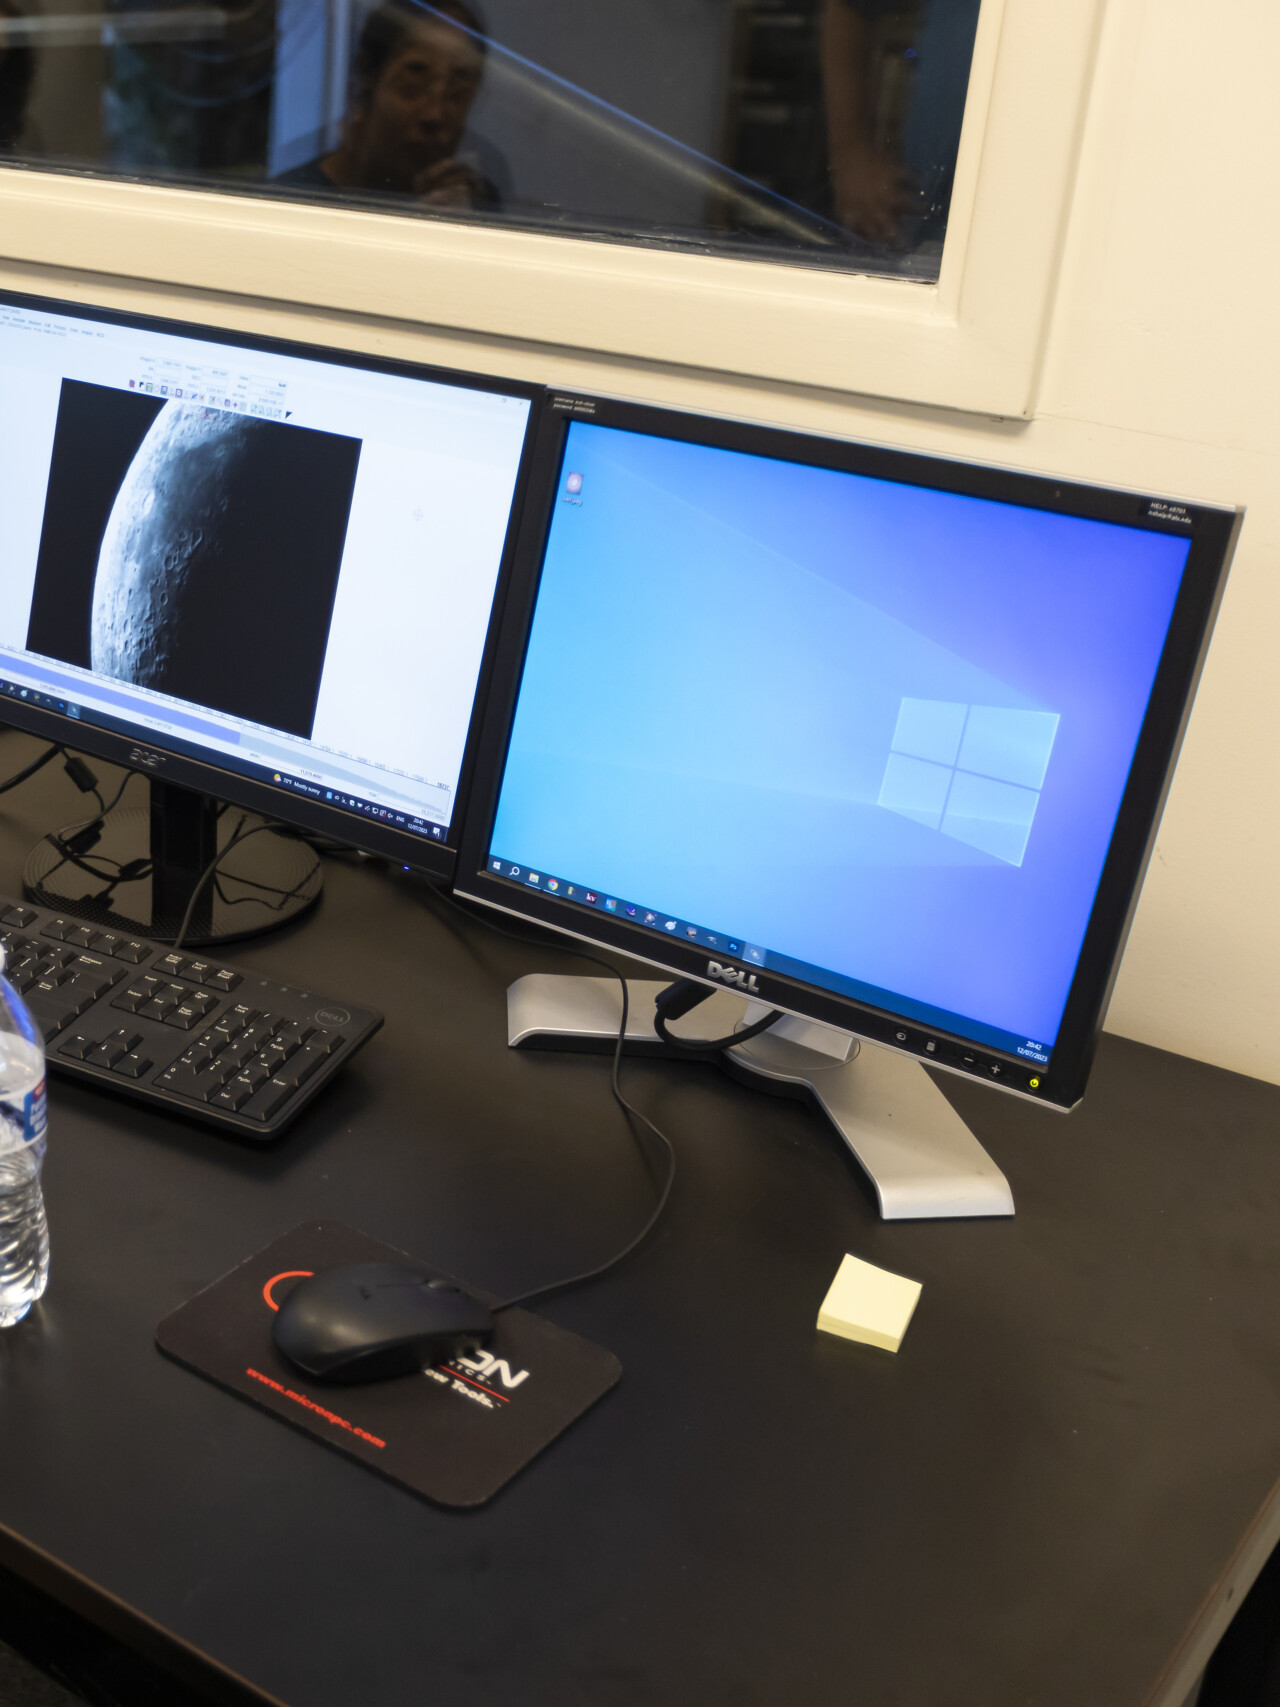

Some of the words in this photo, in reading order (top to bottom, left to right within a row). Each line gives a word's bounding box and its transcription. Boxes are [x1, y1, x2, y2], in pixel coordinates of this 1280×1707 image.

[130, 748, 167, 766] acer
[294, 780, 308, 791] Mostly
[308, 786, 320, 796] sunny
[706, 960, 760, 993] DELL
[320, 1011, 344, 1022] DELL
[1026, 1040, 1042, 1050] 20:42
[1017, 1046, 1048, 1062] 12/07/2023
[246, 1367, 387, 1449] www.micronpc.com
